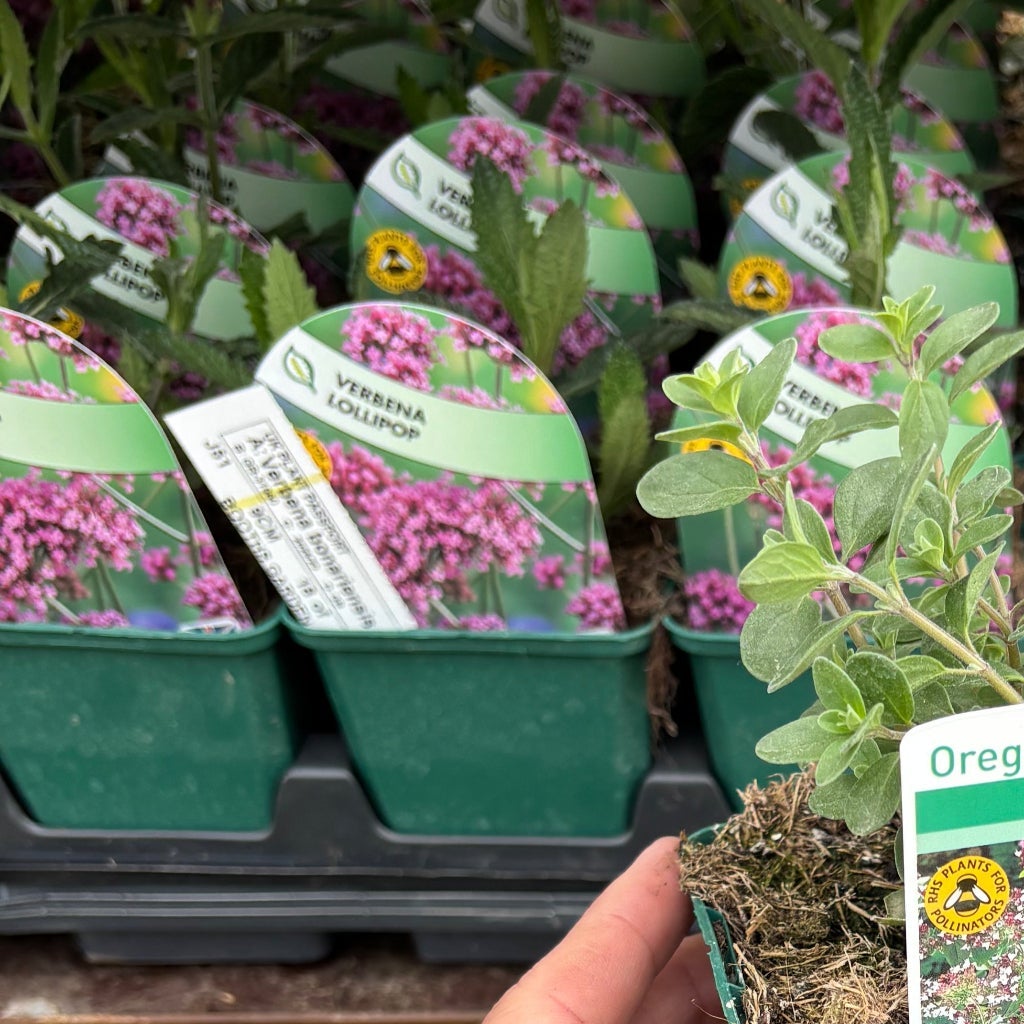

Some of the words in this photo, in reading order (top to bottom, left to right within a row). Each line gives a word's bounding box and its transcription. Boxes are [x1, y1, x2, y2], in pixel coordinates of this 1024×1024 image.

[327, 394, 421, 441] LOLLIPOP
[336, 371, 426, 426] VERBENA
[928, 880, 943, 903] RHS
[941, 858, 992, 879] PLANTS
[990, 870, 1006, 894] FOR
[930, 899, 1004, 932] POLLINATORS
